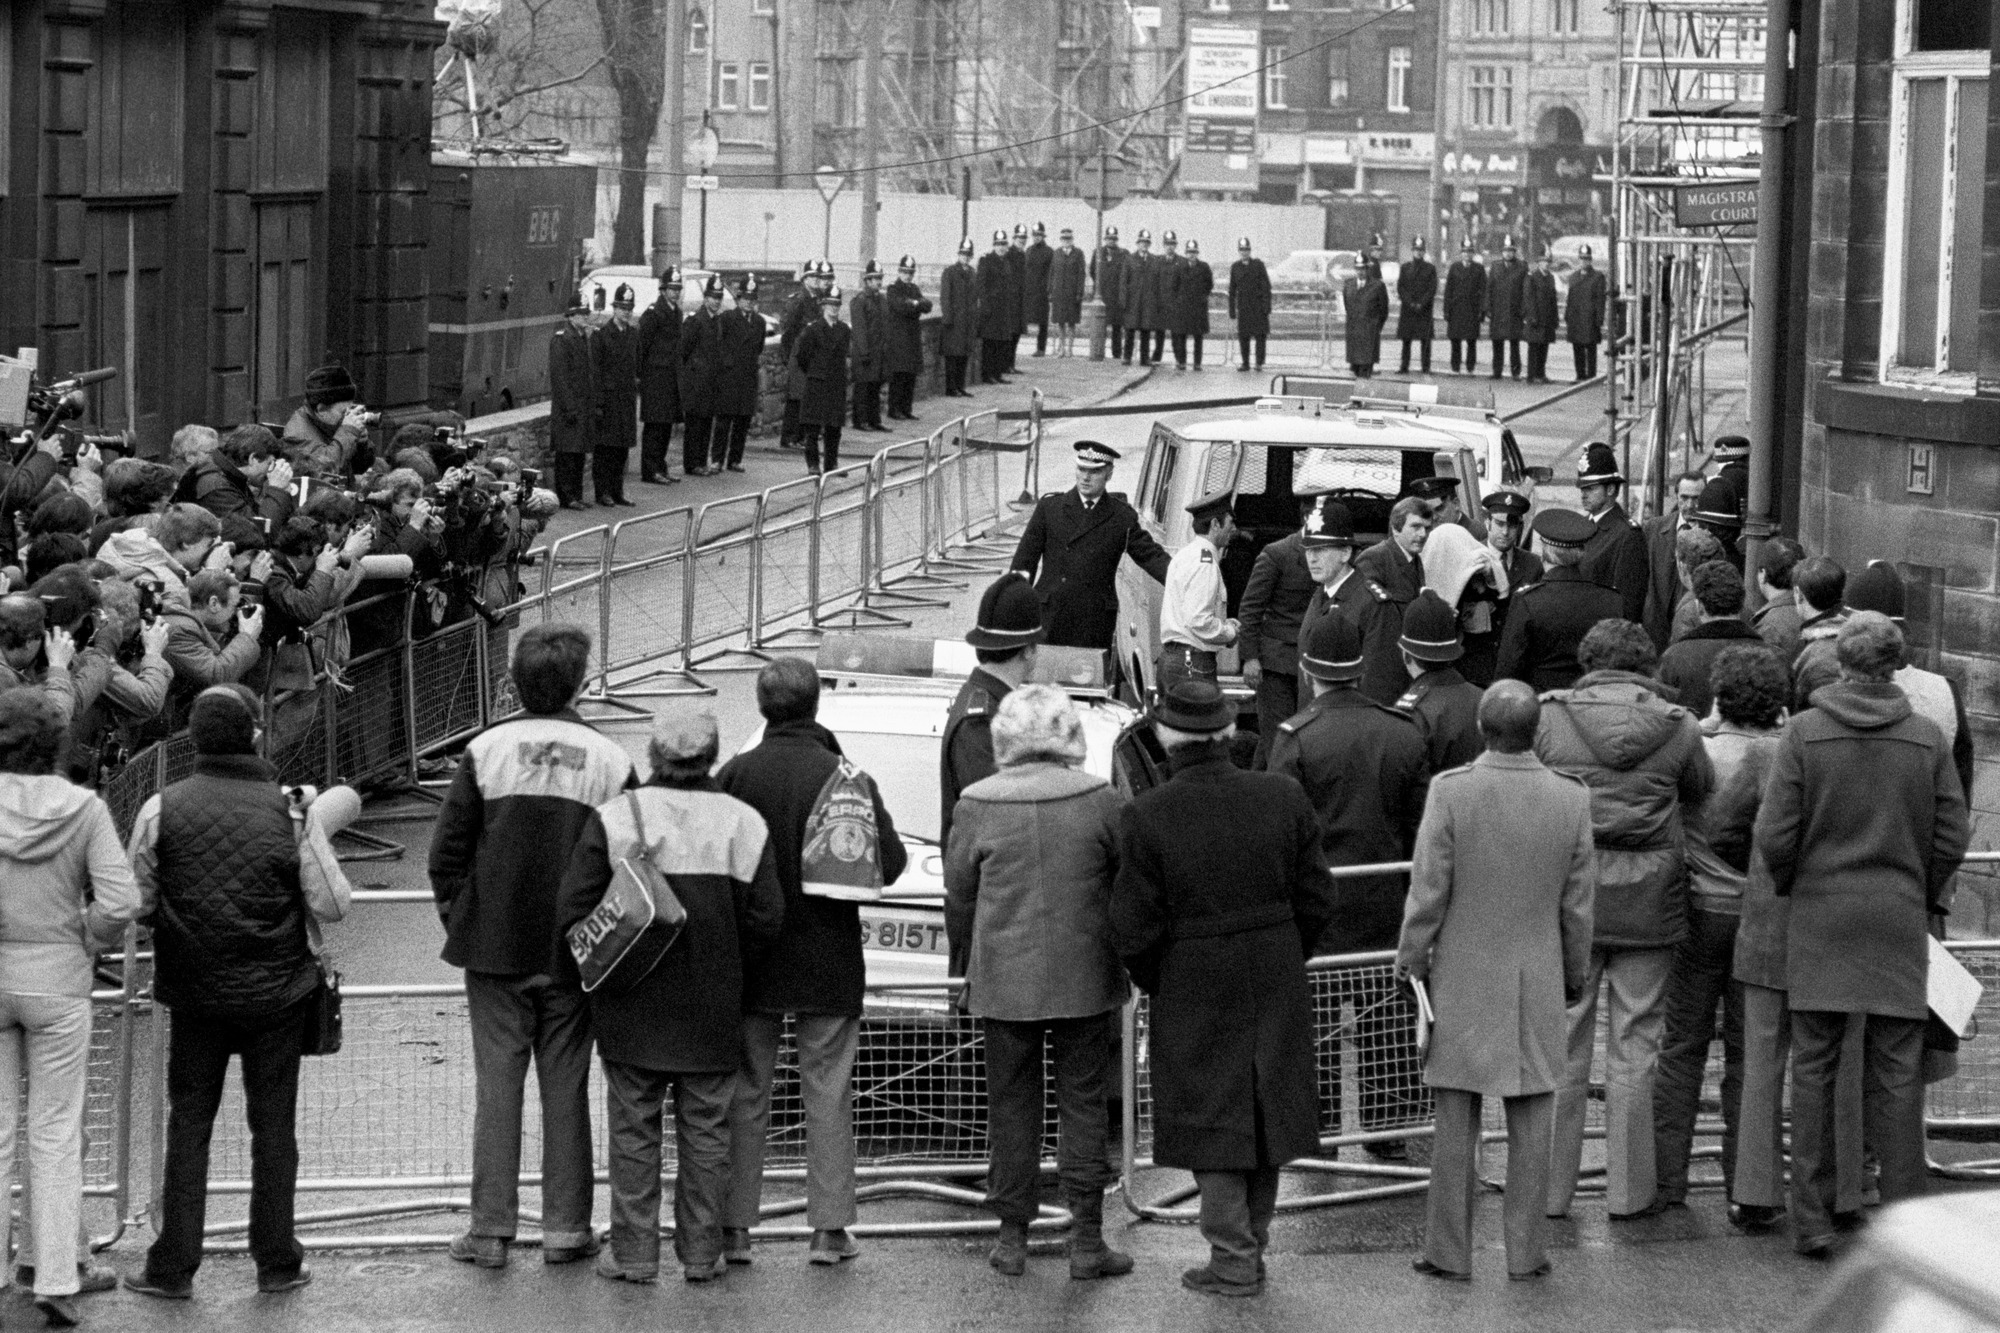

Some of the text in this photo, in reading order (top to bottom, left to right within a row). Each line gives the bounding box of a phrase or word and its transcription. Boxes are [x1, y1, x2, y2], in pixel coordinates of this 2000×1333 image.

[528, 209, 560, 242] BBC
[1711, 207, 1757, 221] COURT
[1910, 448, 1930, 490] H
[570, 892, 625, 965] SPORT
[878, 921, 944, 950] 815T
